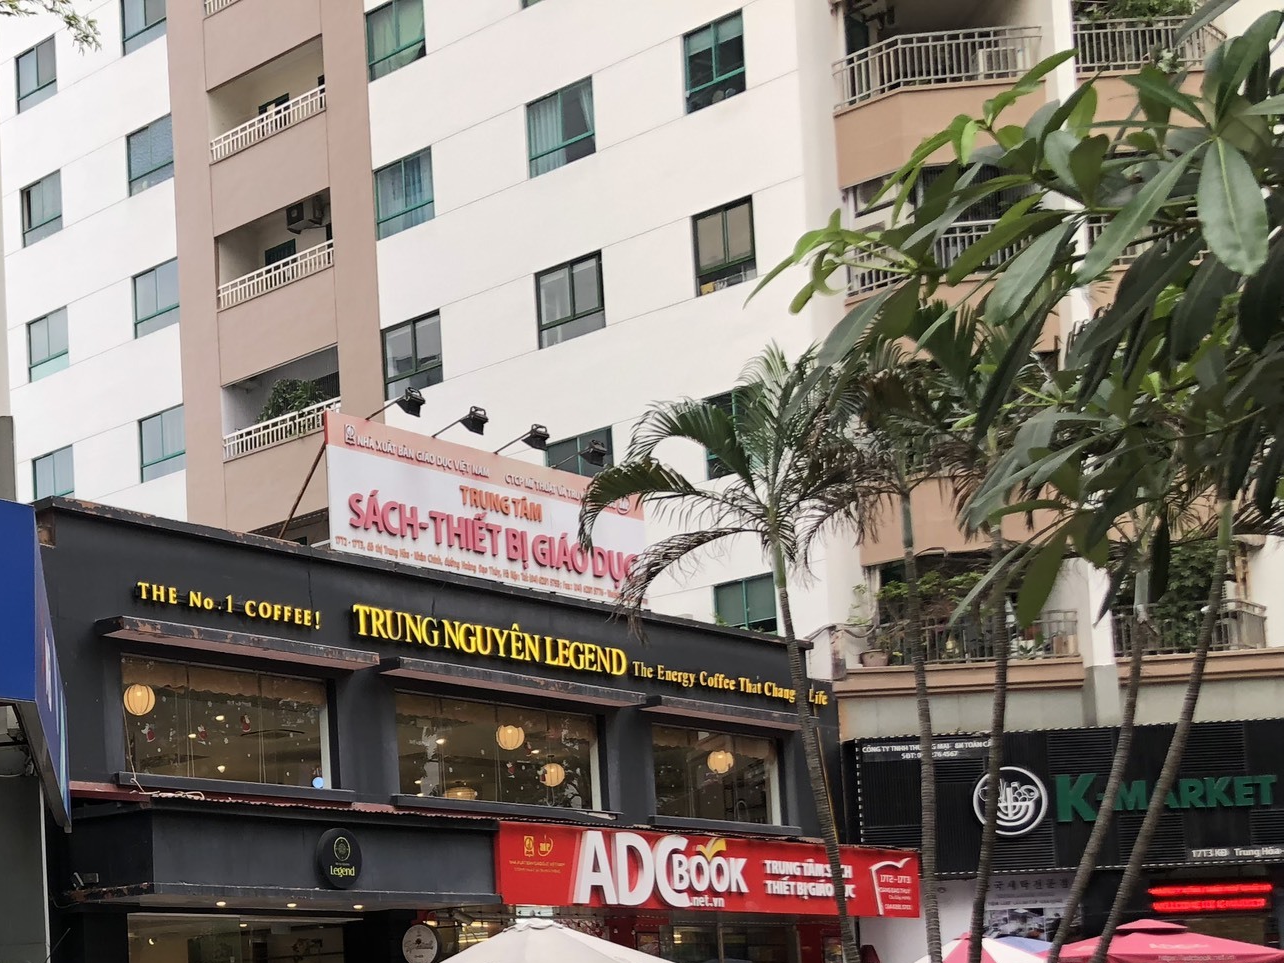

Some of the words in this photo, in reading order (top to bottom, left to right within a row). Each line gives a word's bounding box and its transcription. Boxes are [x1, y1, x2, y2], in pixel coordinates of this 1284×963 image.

[472, 465, 490, 478] NAM
[460, 484, 510, 513] TRUNG
[512, 495, 543, 523] TÂM
[348, 490, 502, 556] SÁCH-THIẾT
[505, 528, 528, 570] BỊ
[531, 532, 589, 574] GIÁO
[137, 582, 178, 605] THE
[244, 600, 321, 630] COFFEE!
[352, 604, 440, 647] TRUNG
[442, 618, 541, 663] NGUYÊN
[544, 636, 627, 676] LEGEND
[632, 660, 654, 678] The
[657, 665, 696, 688] Energy
[700, 671, 736, 690] Coffee
[738, 677, 762, 695] That
[809, 688, 828, 706] Life
[764, 860, 800, 875] TRUNG
[802, 858, 824, 877] TÂM
[1234, 848, 1261, 858] Trung
[330, 865, 355, 878] Legend
[765, 876, 796, 896] THIẾT
